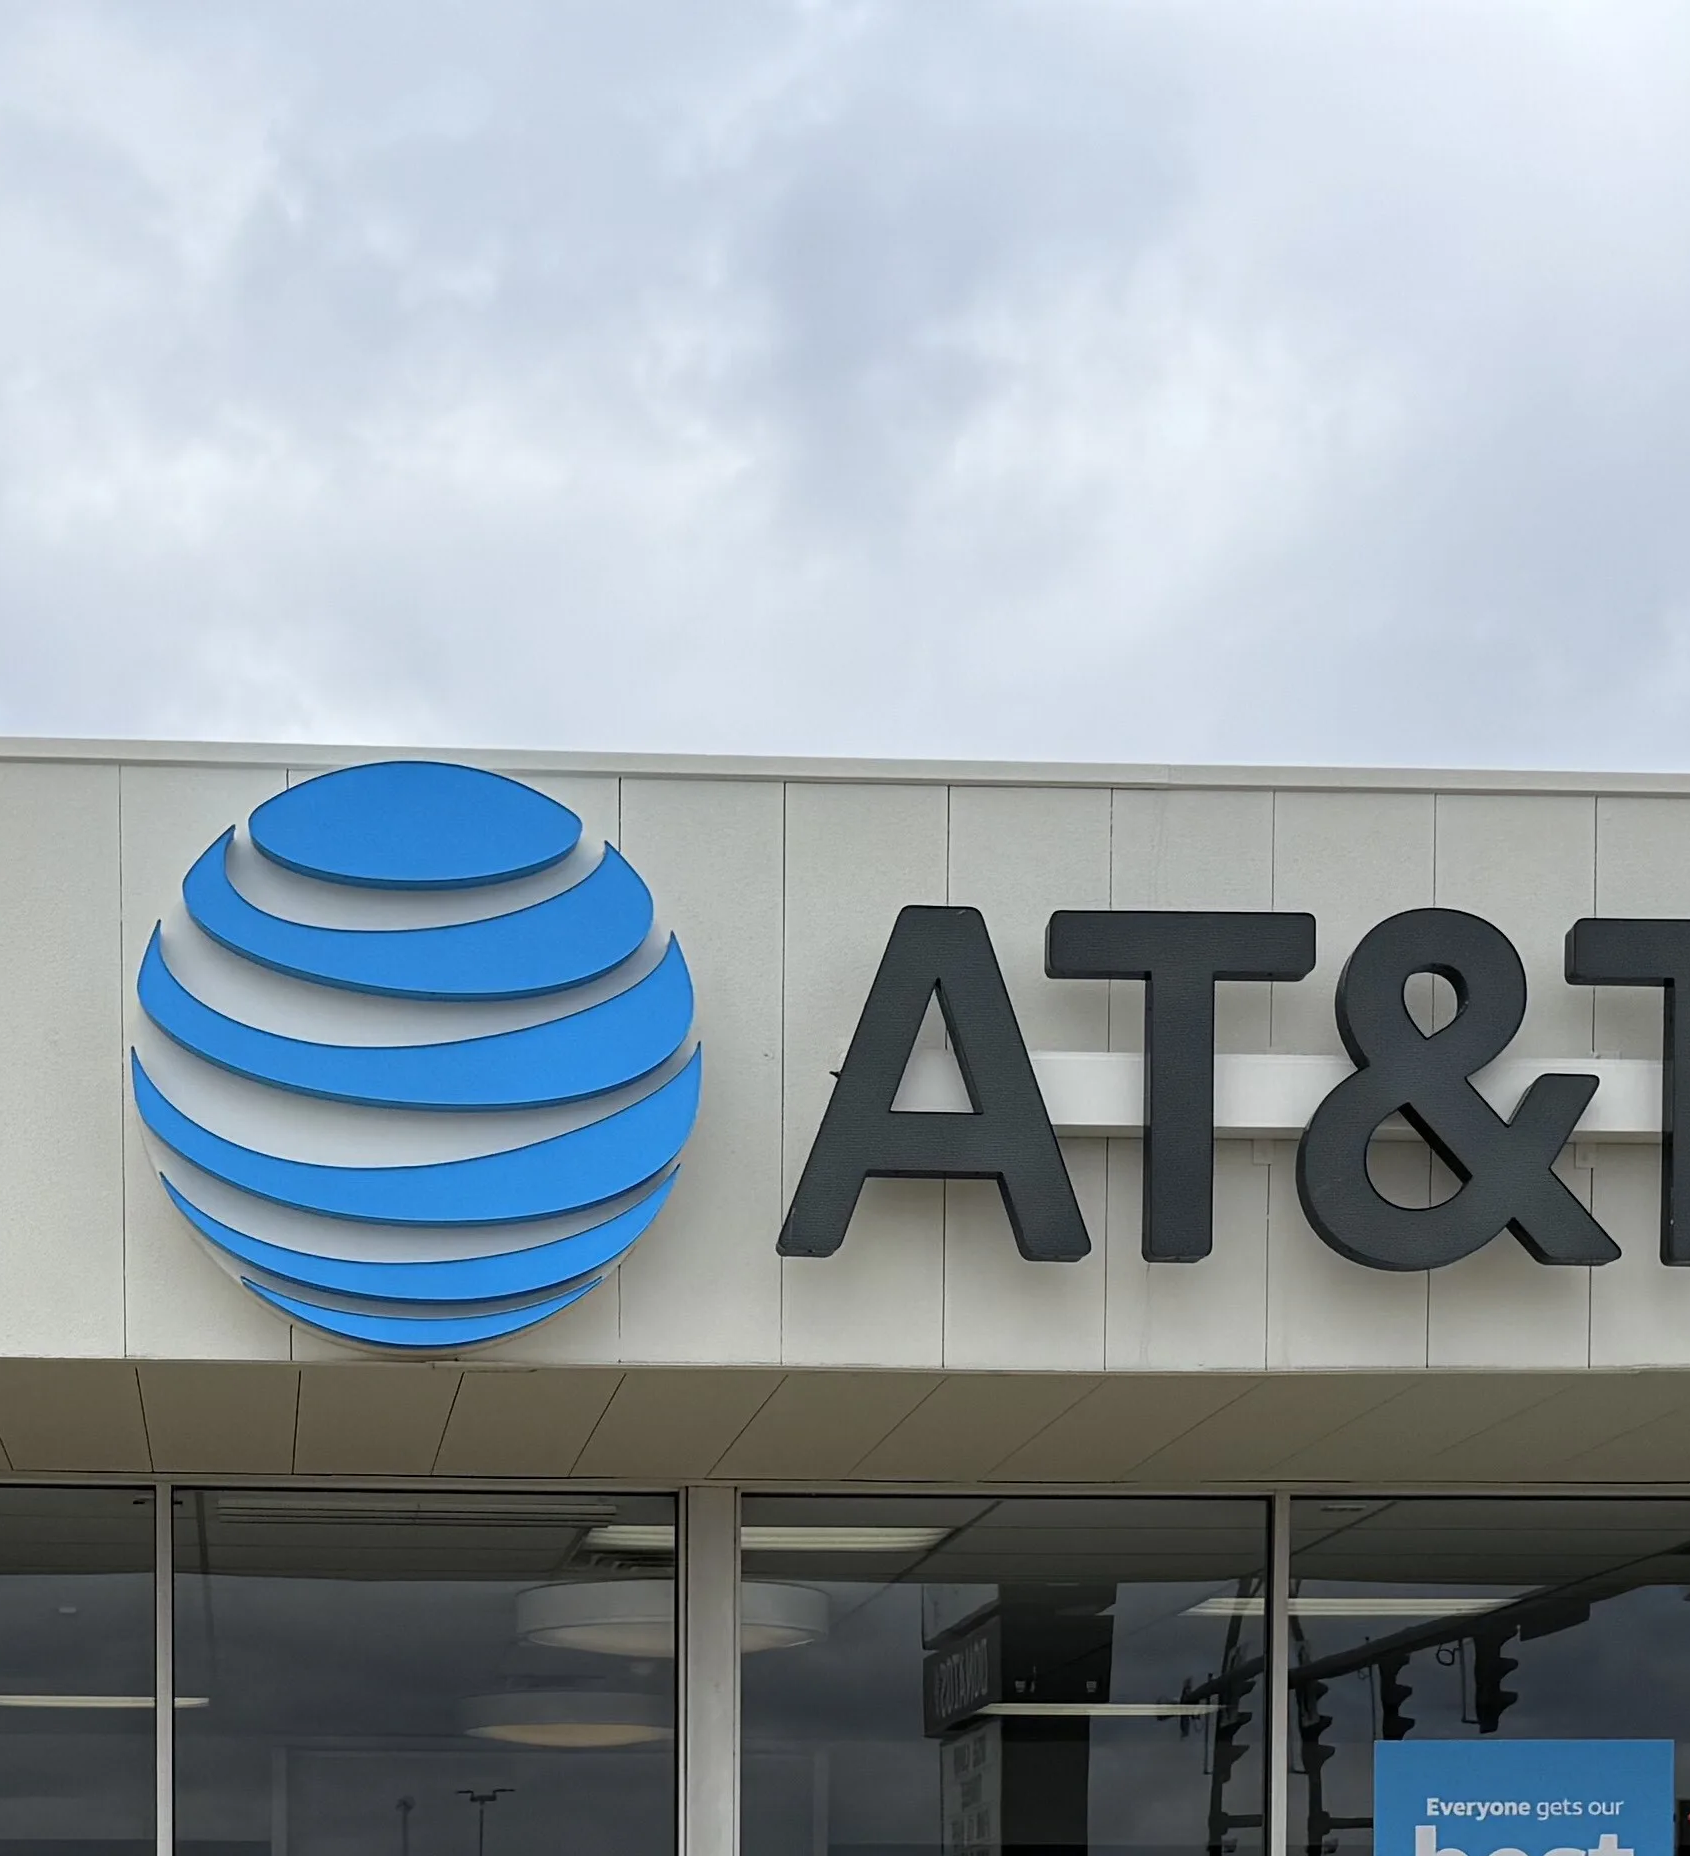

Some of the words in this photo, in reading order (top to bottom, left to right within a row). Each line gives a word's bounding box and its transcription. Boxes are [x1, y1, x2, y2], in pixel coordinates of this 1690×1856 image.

[1426, 1797, 1531, 1820] Everyone
[1537, 1799, 1583, 1820] gets
[1588, 1801, 1624, 1816] our
